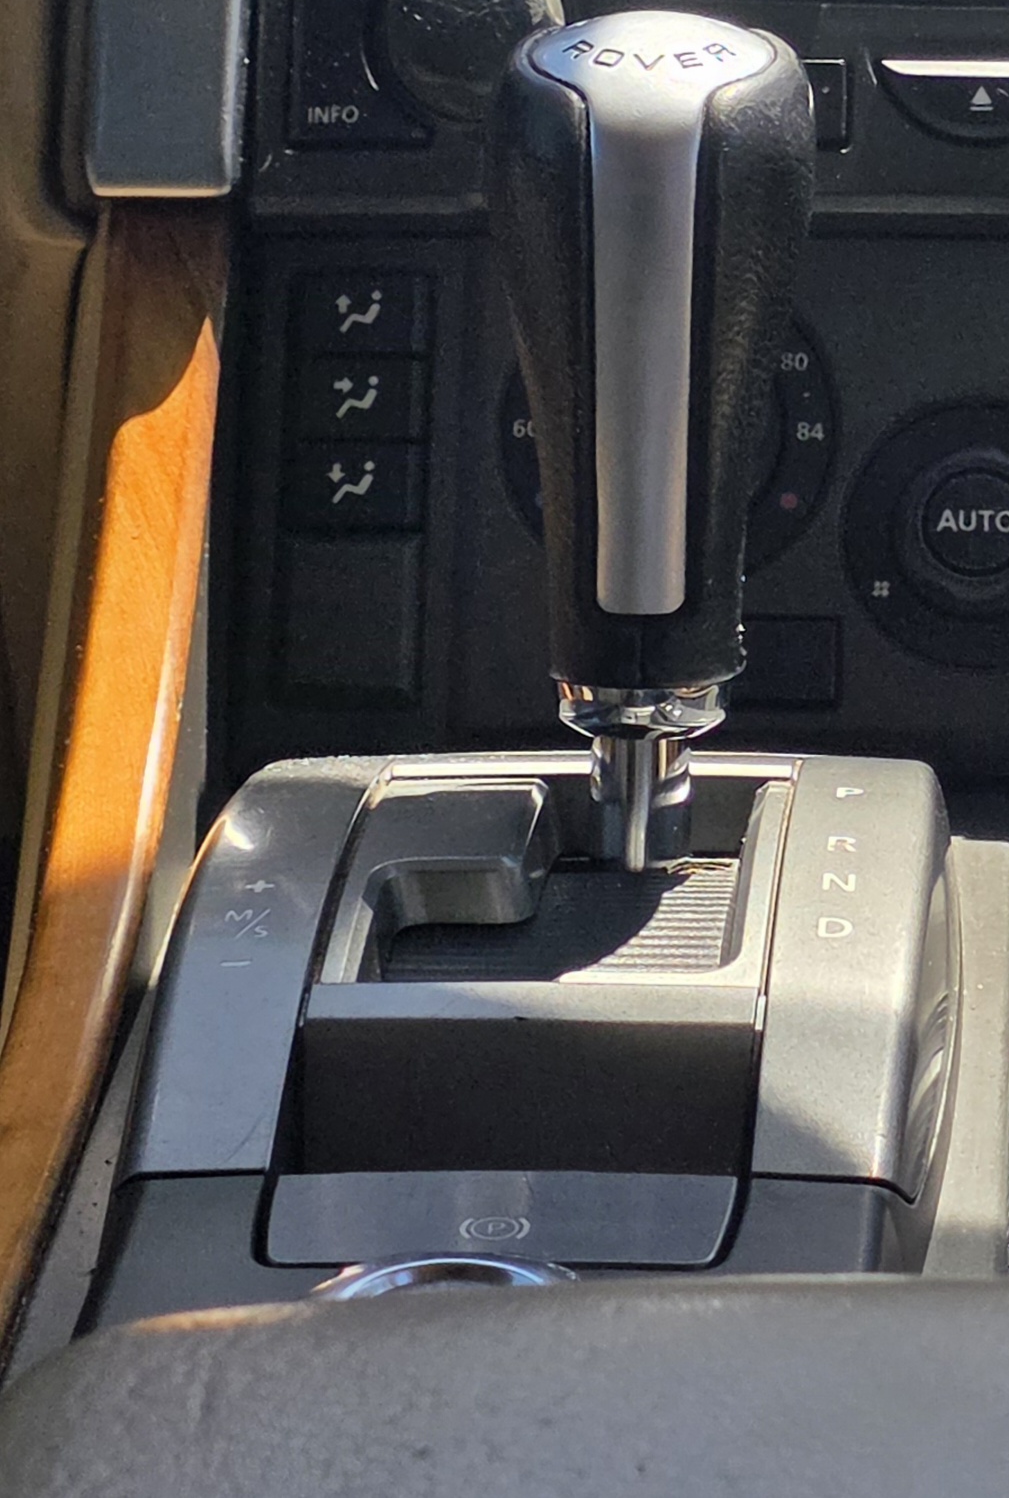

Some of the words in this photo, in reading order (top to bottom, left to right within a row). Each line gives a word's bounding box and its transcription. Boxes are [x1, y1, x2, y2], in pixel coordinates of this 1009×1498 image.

[562, 39, 736, 71] ROVER
[308, 104, 359, 123] INFO
[780, 353, 809, 371] 80
[796, 423, 825, 441] 84
[836, 786, 864, 798] P
[827, 837, 856, 853] R
[822, 873, 856, 891] N
[816, 918, 852, 938] D
